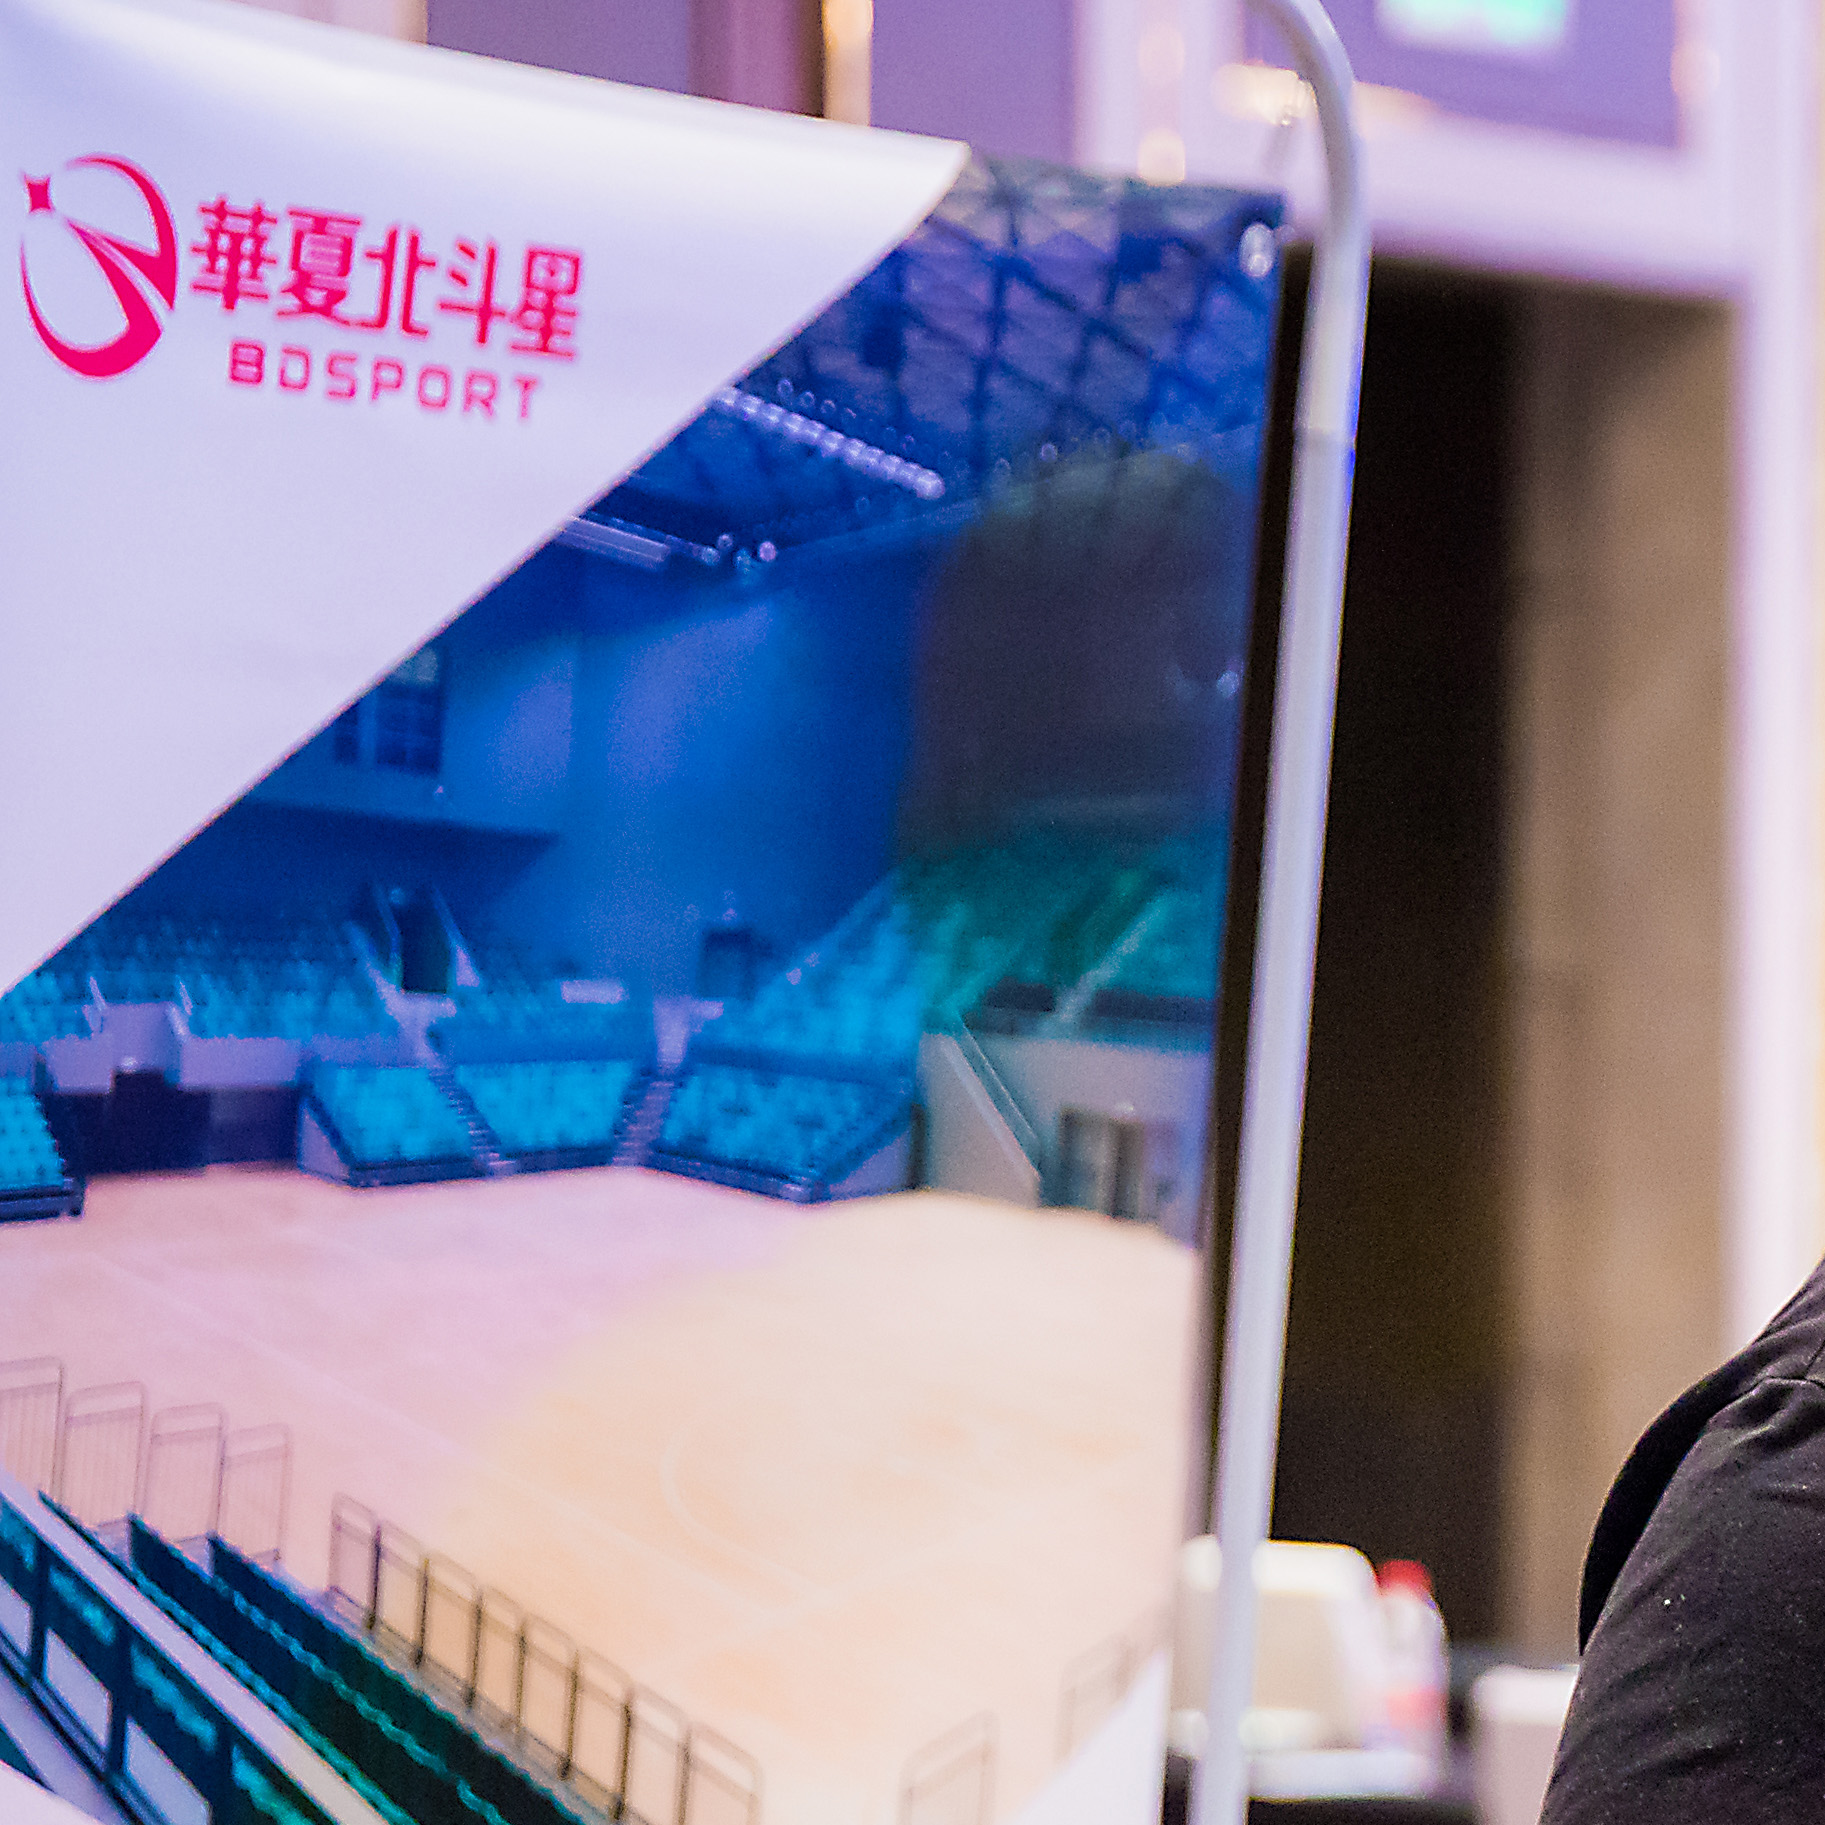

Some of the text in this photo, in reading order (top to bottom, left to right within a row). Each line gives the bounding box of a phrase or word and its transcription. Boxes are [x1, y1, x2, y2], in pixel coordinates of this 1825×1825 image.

[189, 196, 583, 360] 華夏北斗星
[228, 339, 540, 419] BDSPORT
